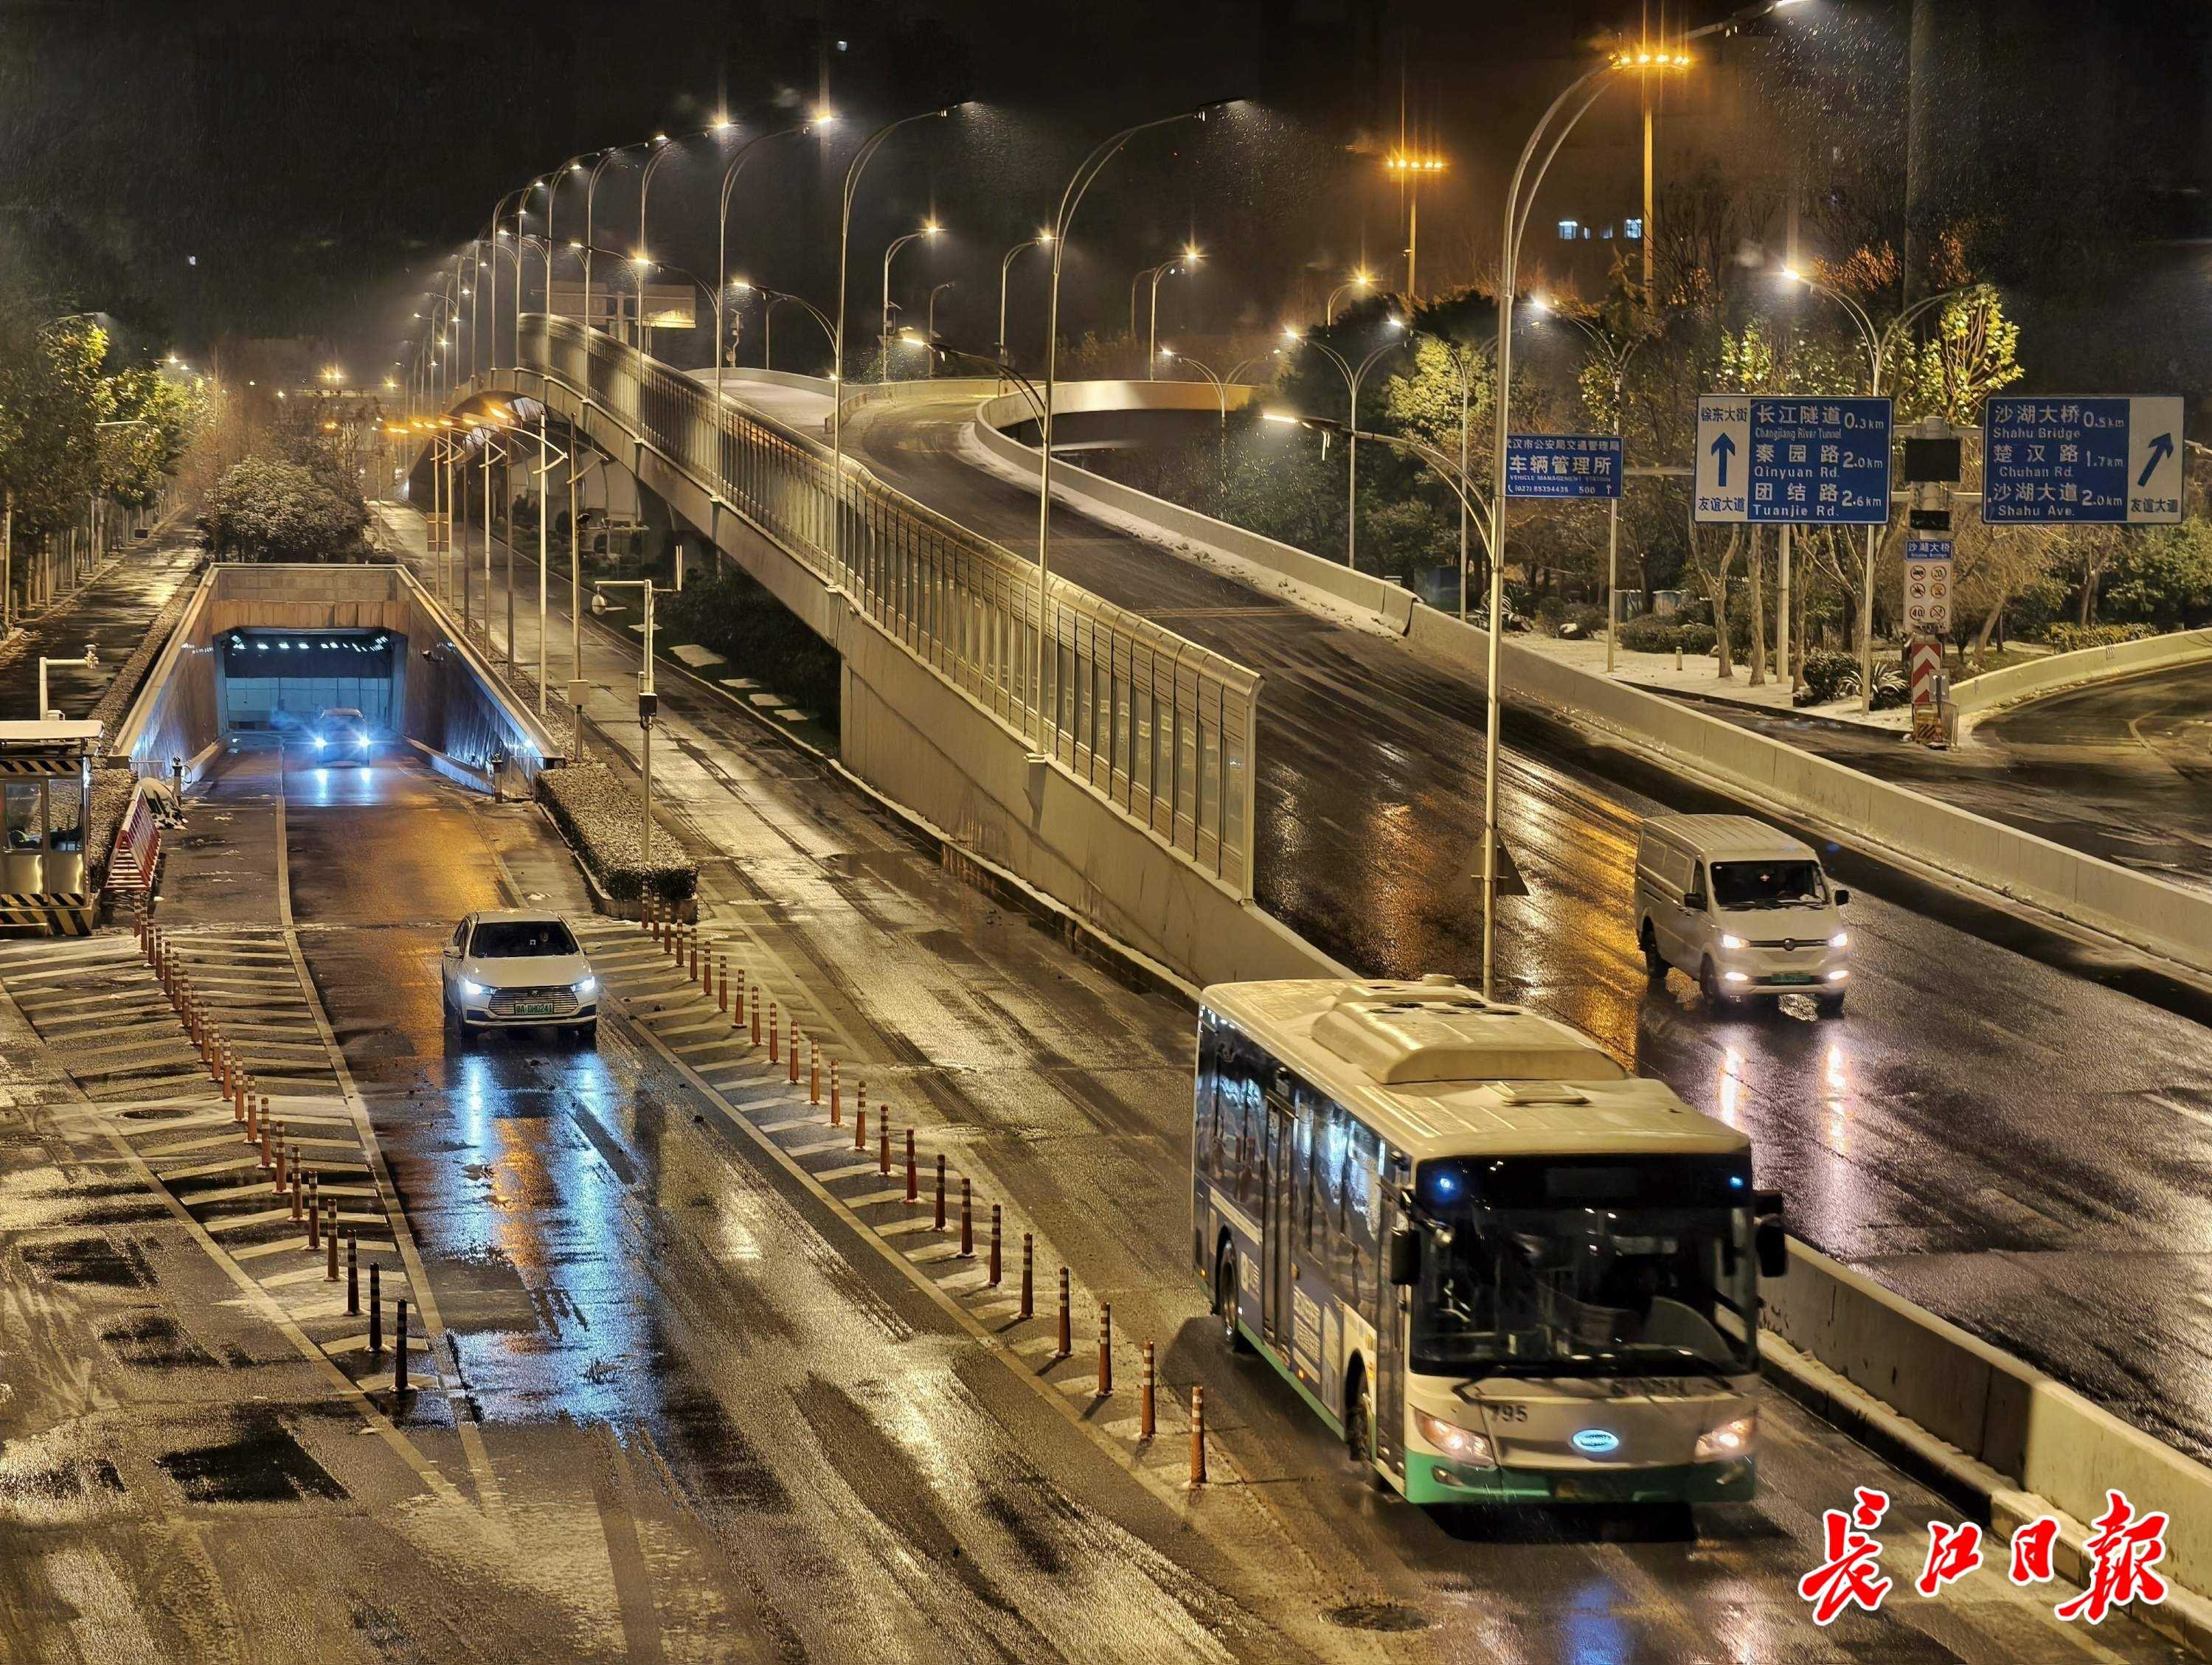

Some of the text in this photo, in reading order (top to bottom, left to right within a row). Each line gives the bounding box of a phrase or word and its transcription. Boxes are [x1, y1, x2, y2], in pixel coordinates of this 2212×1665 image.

[1757, 406, 1842, 425] 长江隧道
[1994, 405, 2079, 424] 沙湖大桥
[1993, 428, 2081, 441] Shahu Bridge
[1755, 444, 1839, 463] 秦园路
[1994, 444, 2078, 463] 楚汉路
[1509, 454, 1612, 474] 车辆管理所
[1754, 465, 1813, 479] Qinyuan
[1999, 466, 2049, 477] Chuhan
[1578, 486, 1596, 494] 500
[1755, 482, 1838, 501] 团结路
[1994, 482, 2078, 502] 沙湖大道
[1698, 497, 1745, 512] 友谊大道
[1753, 504, 1808, 518] Tuanjie
[1998, 505, 2040, 516] Shahu
